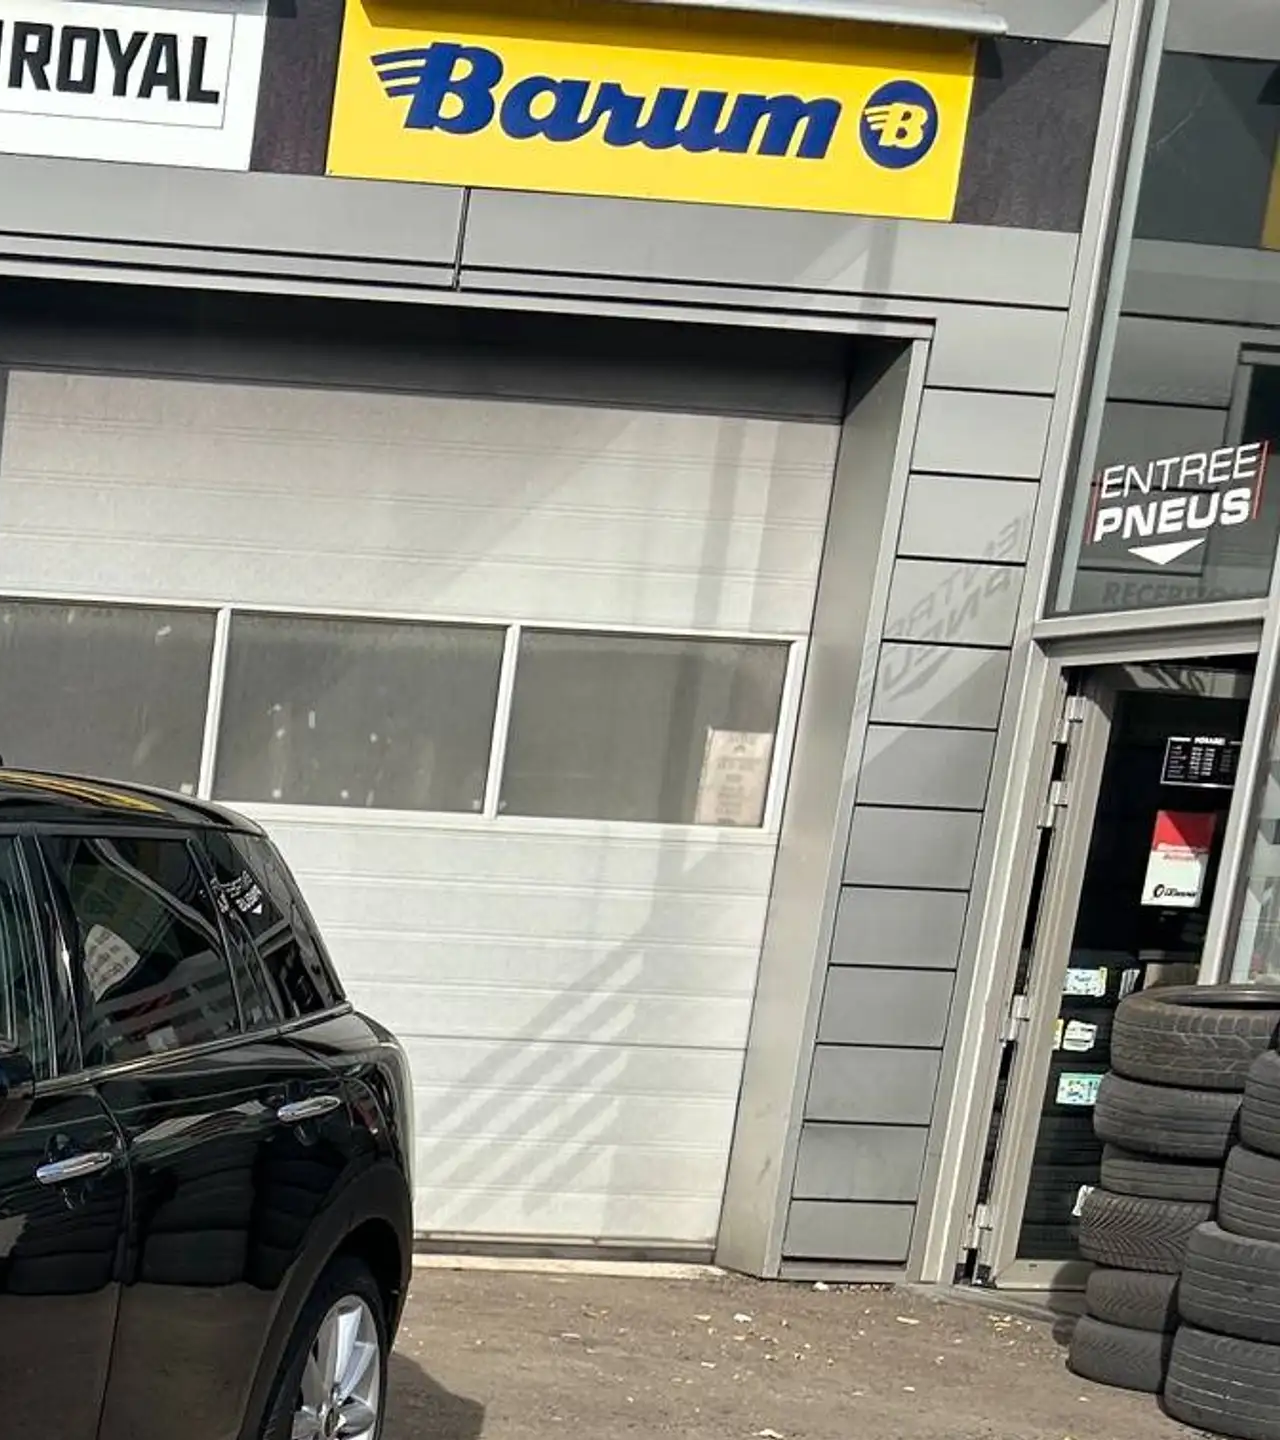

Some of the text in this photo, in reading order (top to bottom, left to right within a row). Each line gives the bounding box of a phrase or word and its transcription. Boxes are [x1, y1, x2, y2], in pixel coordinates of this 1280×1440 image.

[371, 42, 842, 160] Barum
[1100, 442, 1261, 499] ENTREE
[1093, 487, 1252, 542] PNEUS
